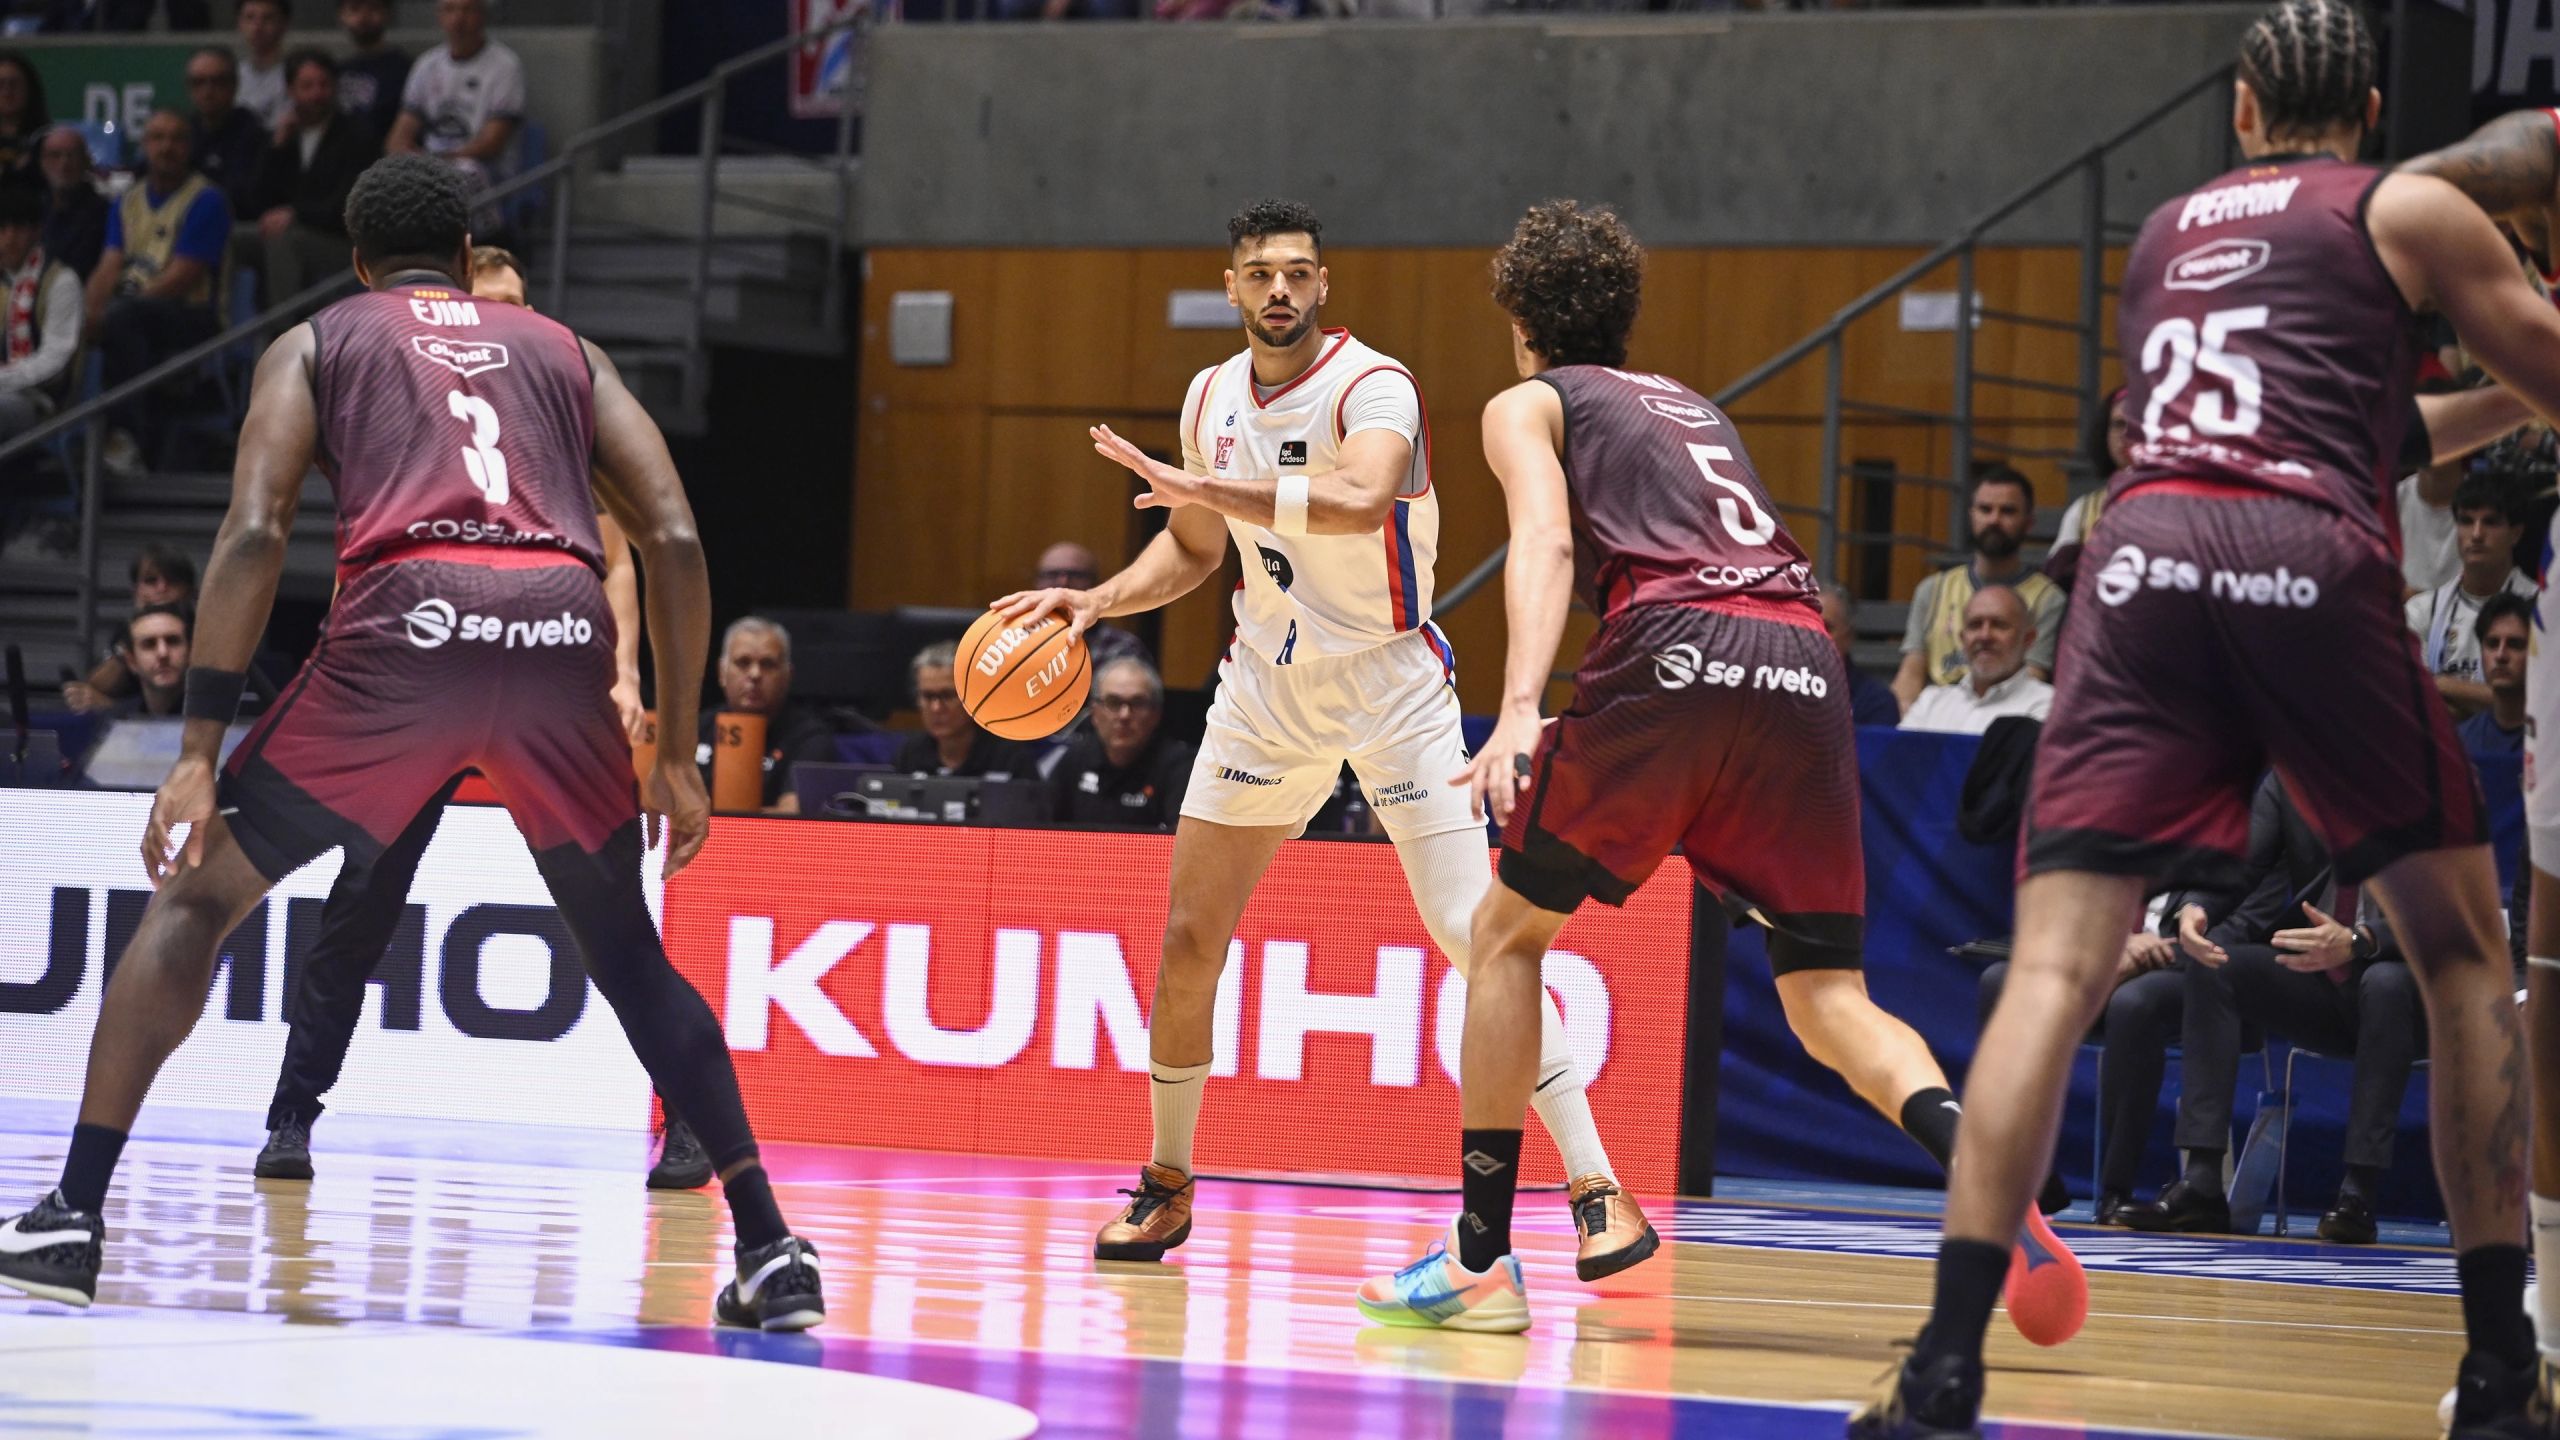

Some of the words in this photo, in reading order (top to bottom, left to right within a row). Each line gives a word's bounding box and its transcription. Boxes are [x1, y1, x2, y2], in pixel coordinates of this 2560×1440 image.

[2177, 177, 2300, 231] PERRIN
[409, 298, 480, 326] EJIM
[2141, 305, 2269, 447] 25
[447, 389, 510, 506] 3
[1686, 442, 1776, 546] 5
